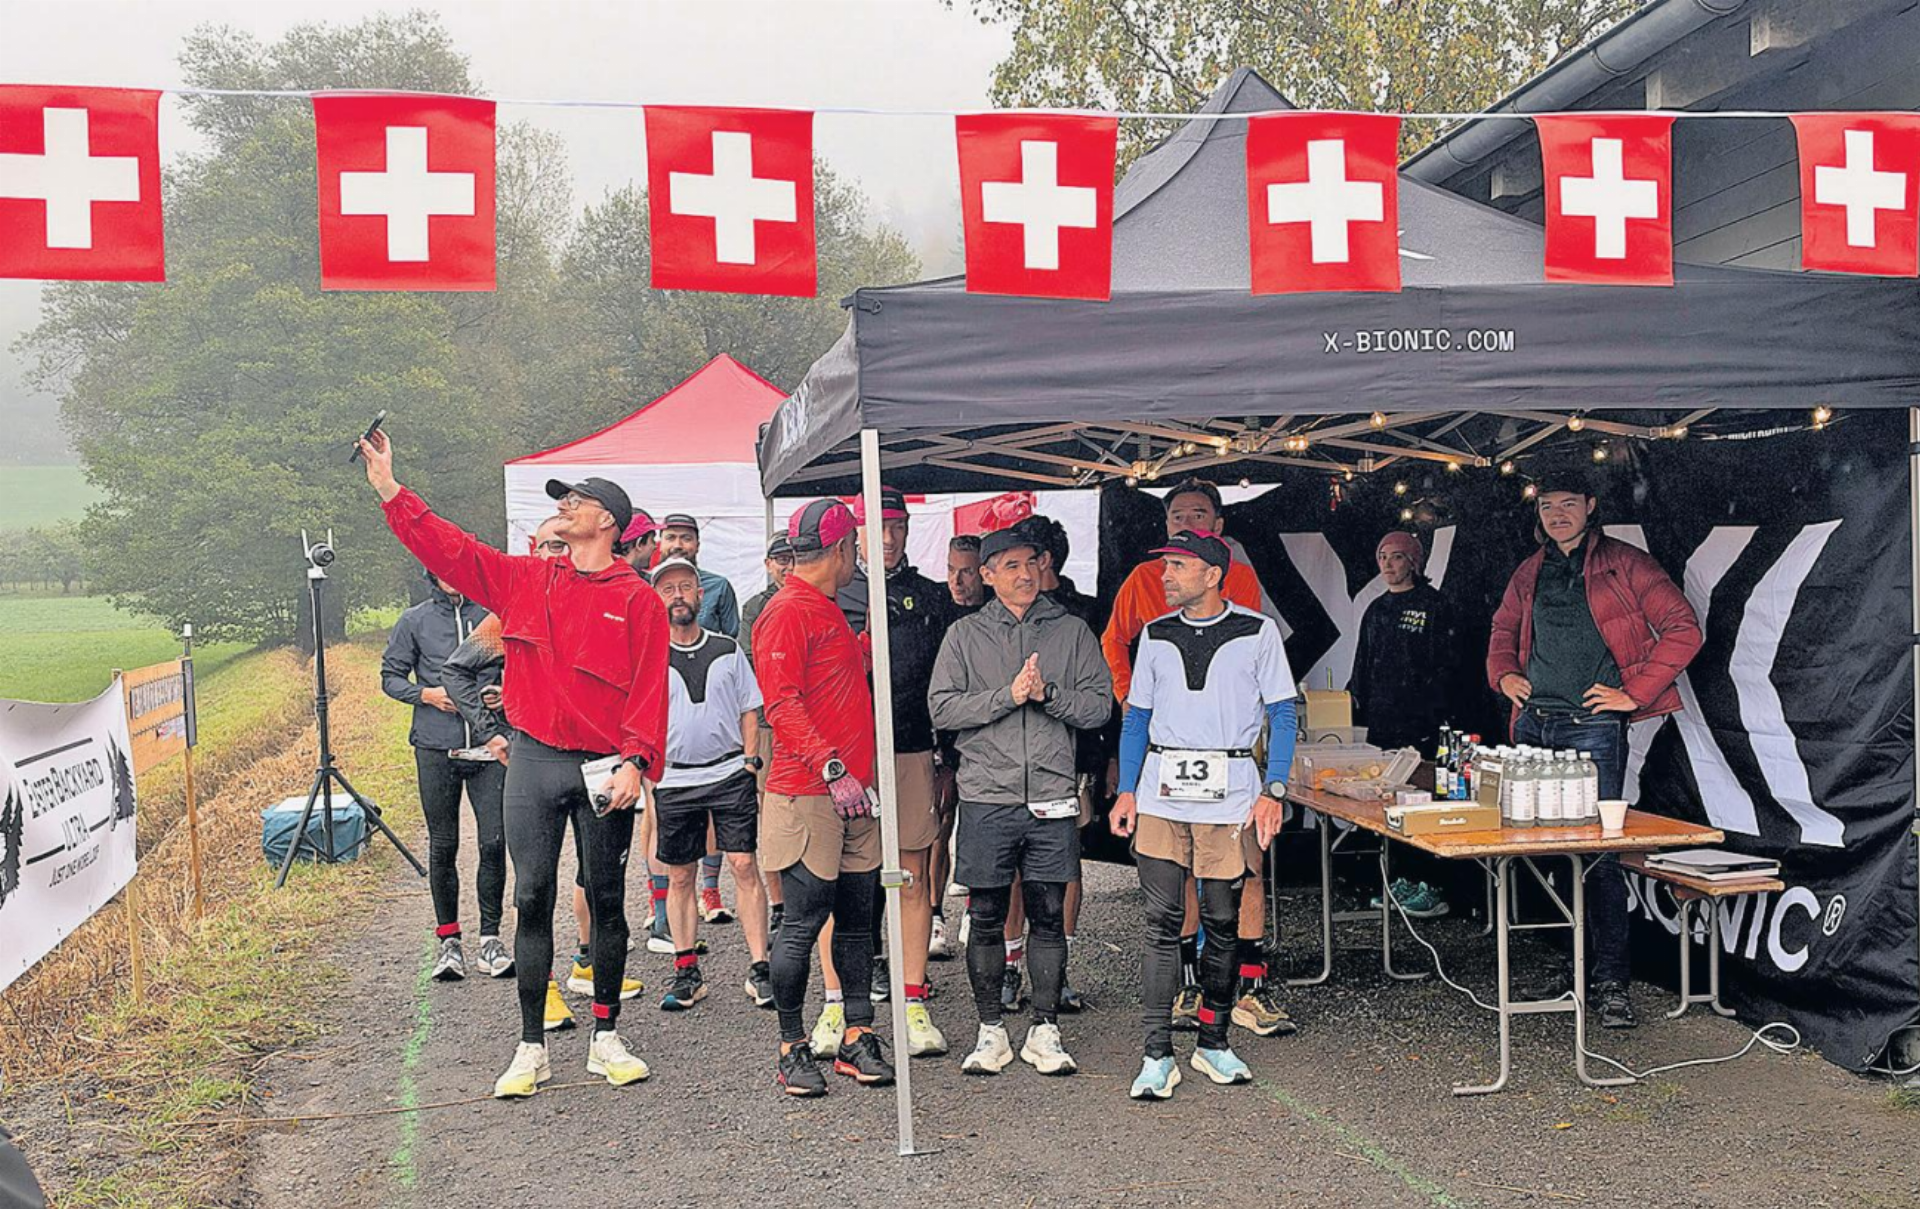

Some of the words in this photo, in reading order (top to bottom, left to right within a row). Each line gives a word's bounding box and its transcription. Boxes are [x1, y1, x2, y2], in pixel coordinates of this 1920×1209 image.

[1323, 329, 1515, 353] X-BIONIC.COM
[50, 758, 104, 804] BACKYARD
[1175, 760, 1209, 781] 13
[62, 812, 90, 851] ULTRA
